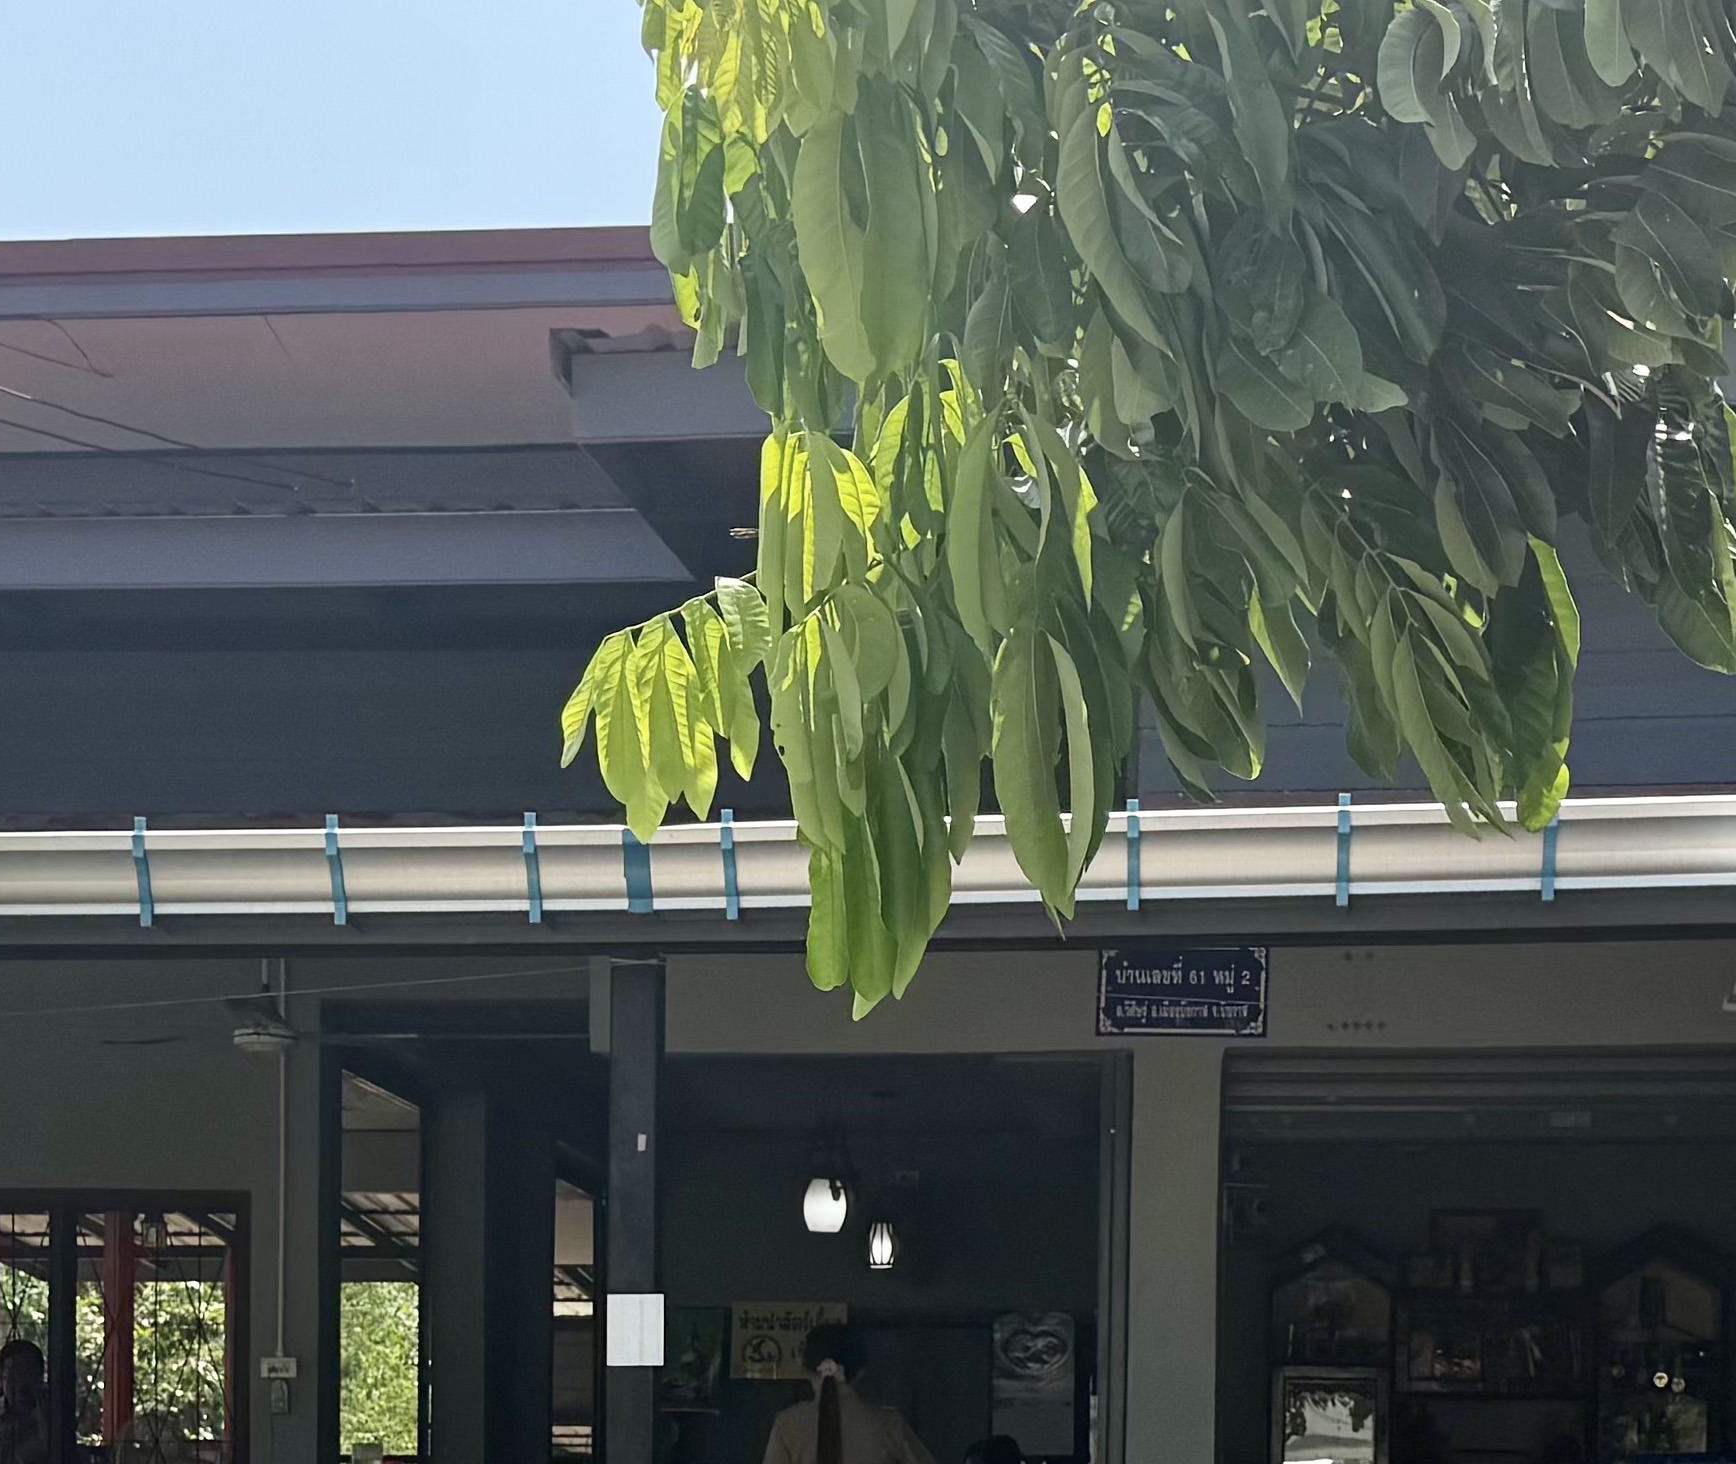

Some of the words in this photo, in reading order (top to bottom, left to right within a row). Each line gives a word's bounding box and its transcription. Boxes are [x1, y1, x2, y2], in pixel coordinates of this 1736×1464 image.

[1115, 955, 1183, 985] บ้านเลขที่
[1189, 970, 1205, 985] 61
[1213, 964, 1235, 994] หมู่
[1240, 970, 1251, 985] 2
